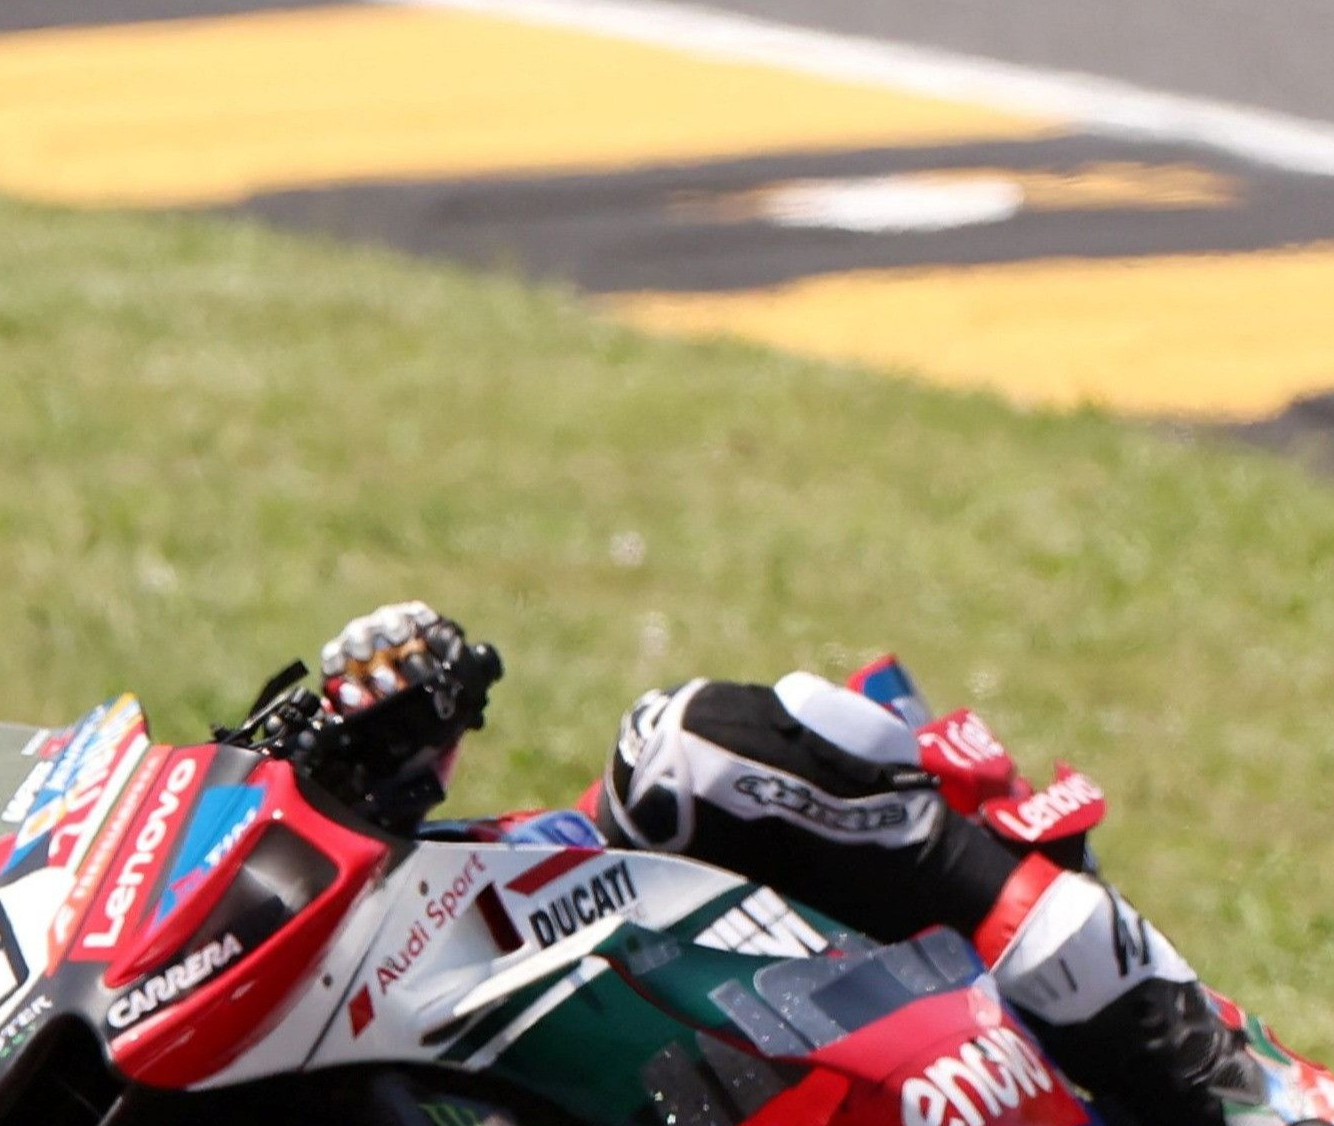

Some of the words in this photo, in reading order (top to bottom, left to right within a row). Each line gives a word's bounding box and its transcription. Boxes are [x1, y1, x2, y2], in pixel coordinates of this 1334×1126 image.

[83, 758, 197, 948] Lenovo
[529, 862, 638, 949] DUCATI
[106, 932, 243, 1028] CARRERA
[374, 929, 430, 995] Audi
[427, 850, 489, 928] Sport
